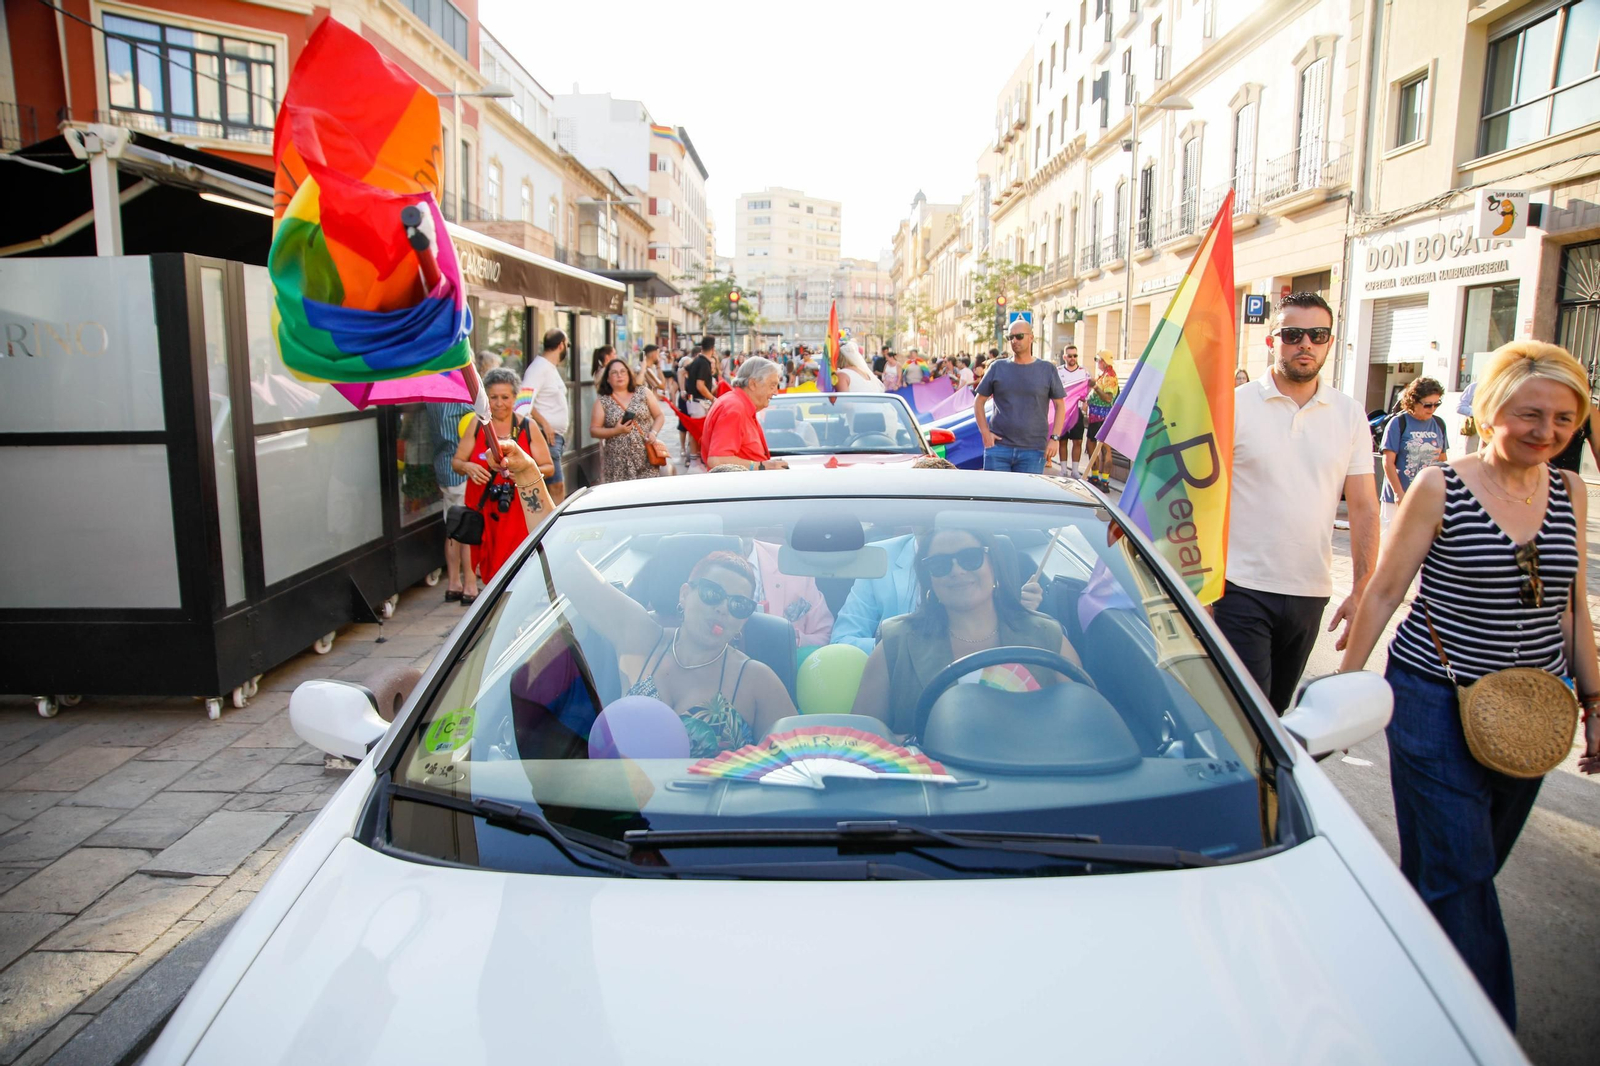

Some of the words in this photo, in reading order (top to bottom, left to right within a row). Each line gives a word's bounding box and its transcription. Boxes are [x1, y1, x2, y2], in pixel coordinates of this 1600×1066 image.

[1366, 240, 1408, 272] DON
[1365, 278, 1397, 291] CAFETERIA
[1400, 271, 1437, 287] BOCATERIA
[1439, 260, 1509, 281] HAMBURGUESERIA
[1250, 299, 1261, 312] P
[0, 322, 108, 357] RINO
[1410, 431, 1438, 439] TOKYO
[1145, 432, 1220, 577] Regal
